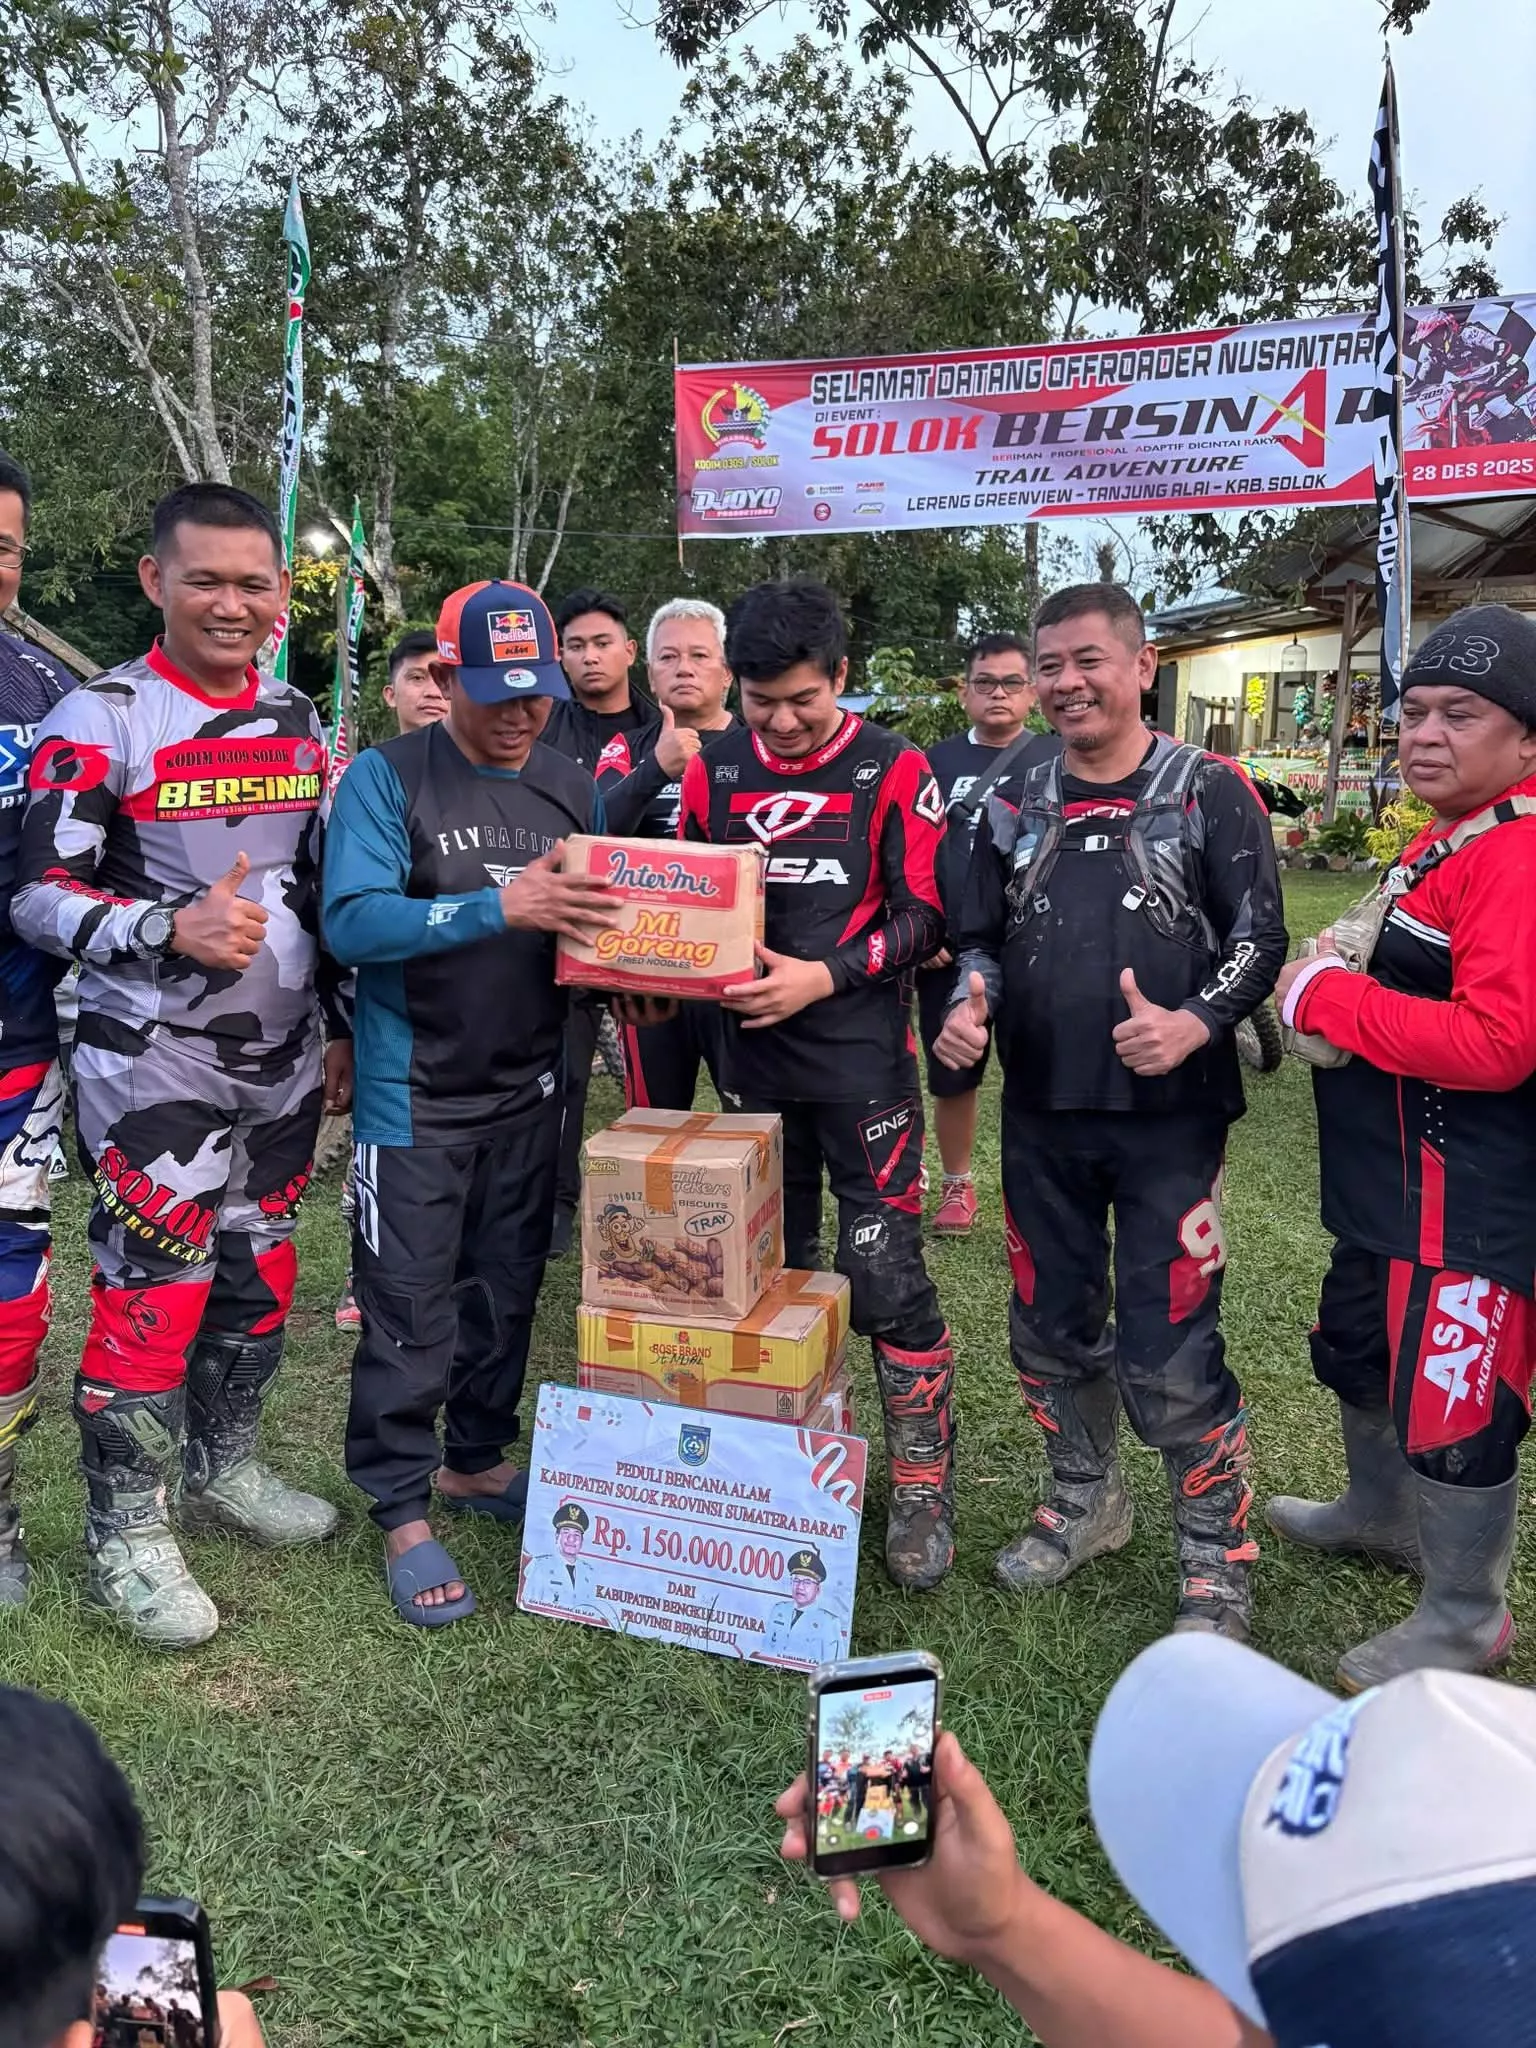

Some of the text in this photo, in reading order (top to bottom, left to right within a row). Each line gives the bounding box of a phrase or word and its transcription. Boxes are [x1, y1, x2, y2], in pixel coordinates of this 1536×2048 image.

[811, 330, 1376, 406] SELAMAT DATANG OFFROADER NUSANTAR
[815, 412, 829, 423] DI
[832, 409, 874, 422] EVENT
[811, 414, 985, 460] SOLOK
[991, 452, 1042, 462] BERIMAN
[1050, 446, 1128, 459] PROFESIONAL
[1135, 442, 1185, 453] ADAPTIF
[1188, 438, 1241, 450] DICINTAI
[974, 454, 1250, 486] TRAIL ADVENTURE
[1412, 458, 1534, 481] 28 DES 2025
[694, 487, 782, 510] DJOYO
[907, 494, 970, 512] LERENG
[974, 487, 1073, 508] GREENVIEW
[1087, 484, 1168, 502] TANJUNG
[1170, 481, 1209, 498] ALAI
[1225, 478, 1266, 495] KAB.
[1268, 474, 1328, 492] SOLOK
[157, 774, 320, 809] BERSINAR
[437, 825, 554, 856] FLY RACIN
[765, 858, 850, 885] SA
[631, 909, 682, 938] Mi
[594, 929, 719, 968] Goreng
[617, 955, 692, 970] FRIED NOODLES
[865, 1108, 910, 1142] ONE
[93, 1168, 209, 1265] ENDURO TEAM
[678, 1199, 729, 1210] BISCUITS
[690, 1213, 728, 1233] TRAY
[855, 1223, 882, 1246] 017
[678, 1345, 712, 1358] BRAND
[1475, 1285, 1511, 1407] RACING TEAM
[615, 1462, 771, 1503] PEDULI BENCANA ALAM
[540, 1468, 847, 1540] KABUPATEN SOLOK PROVINSI SUMATERA BARAT
[592, 1515, 785, 1581] Rp. 150.000.000
[667, 1581, 696, 1599] DARI
[595, 1585, 767, 1634] KABUPATEN BENGKULU UTARA
[620, 1608, 738, 1646] PROVINSI BENGKULU
